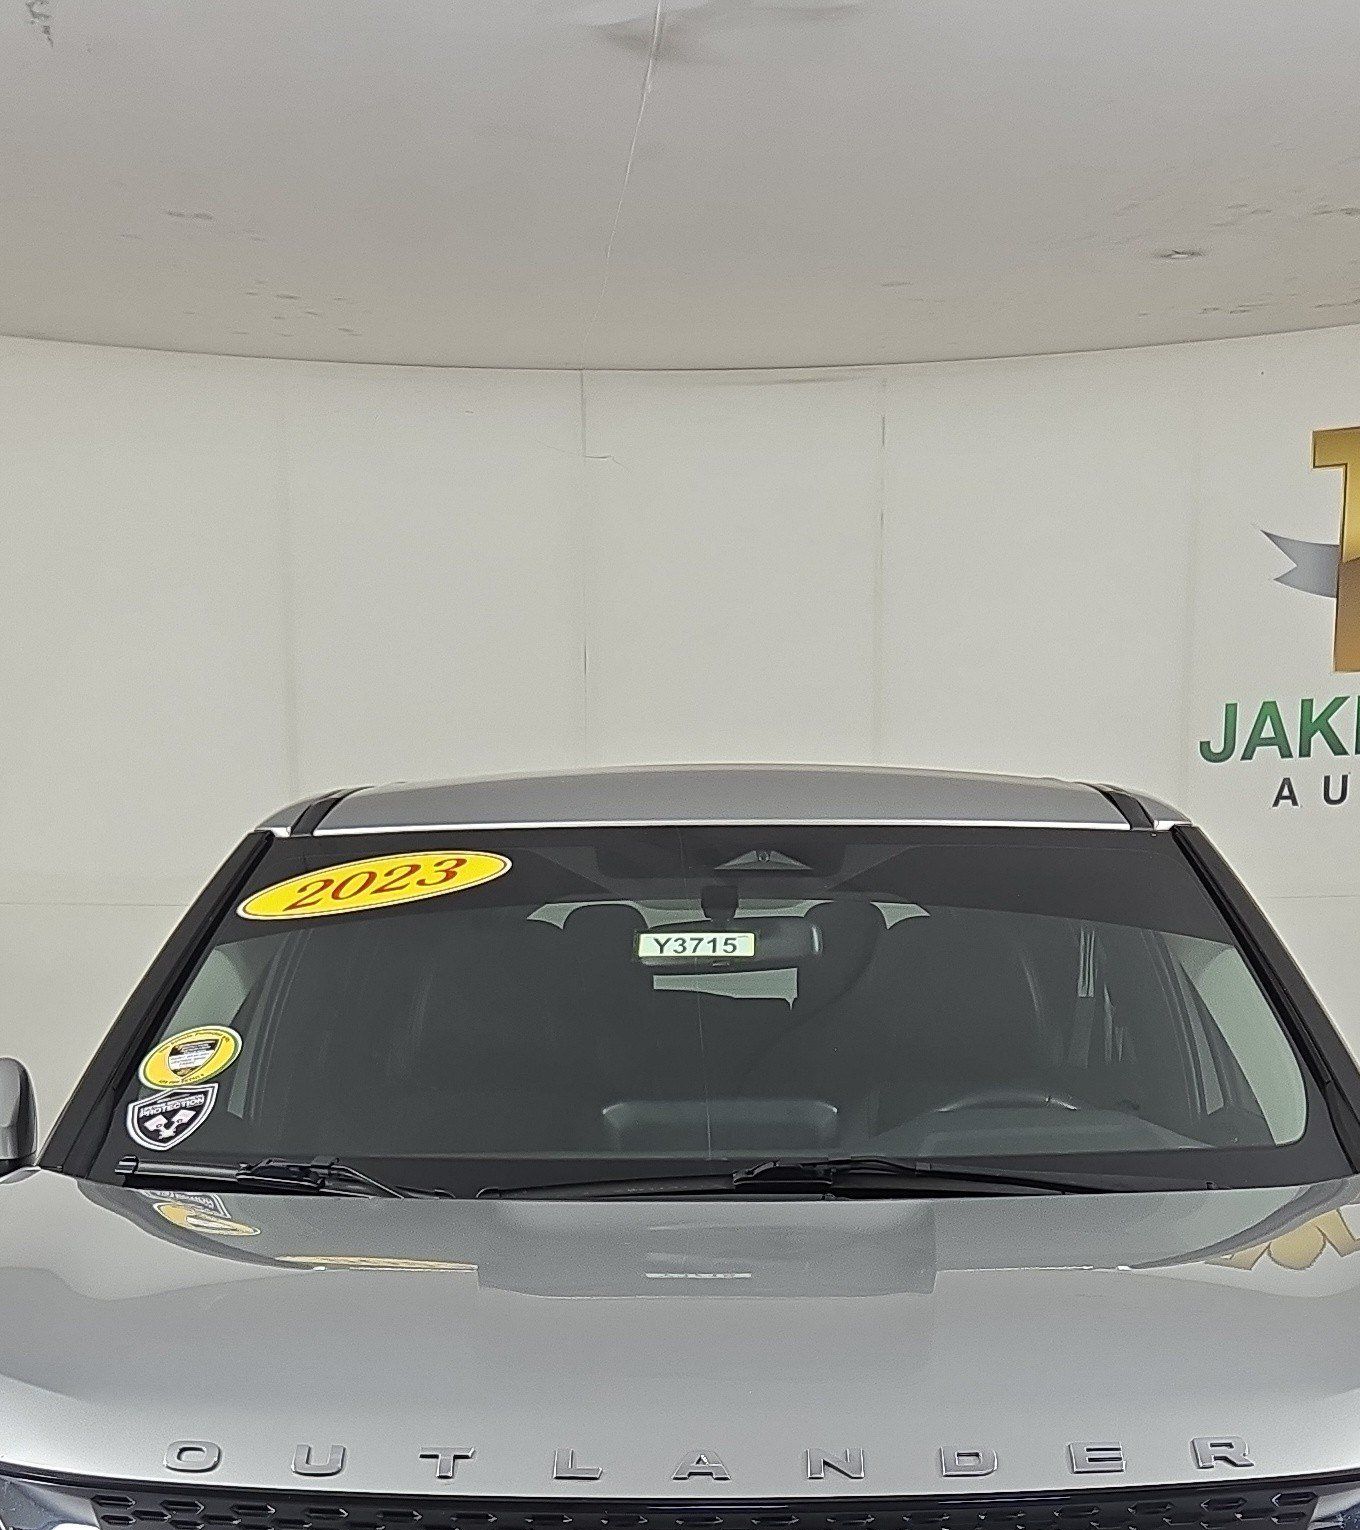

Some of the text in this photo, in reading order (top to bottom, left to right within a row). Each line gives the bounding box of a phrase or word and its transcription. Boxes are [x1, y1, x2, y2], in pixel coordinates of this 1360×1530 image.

[282, 858, 468, 912] 2023
[653, 937, 738, 954] Y3715
[163, 1435, 1255, 1481] OUTLANDER
